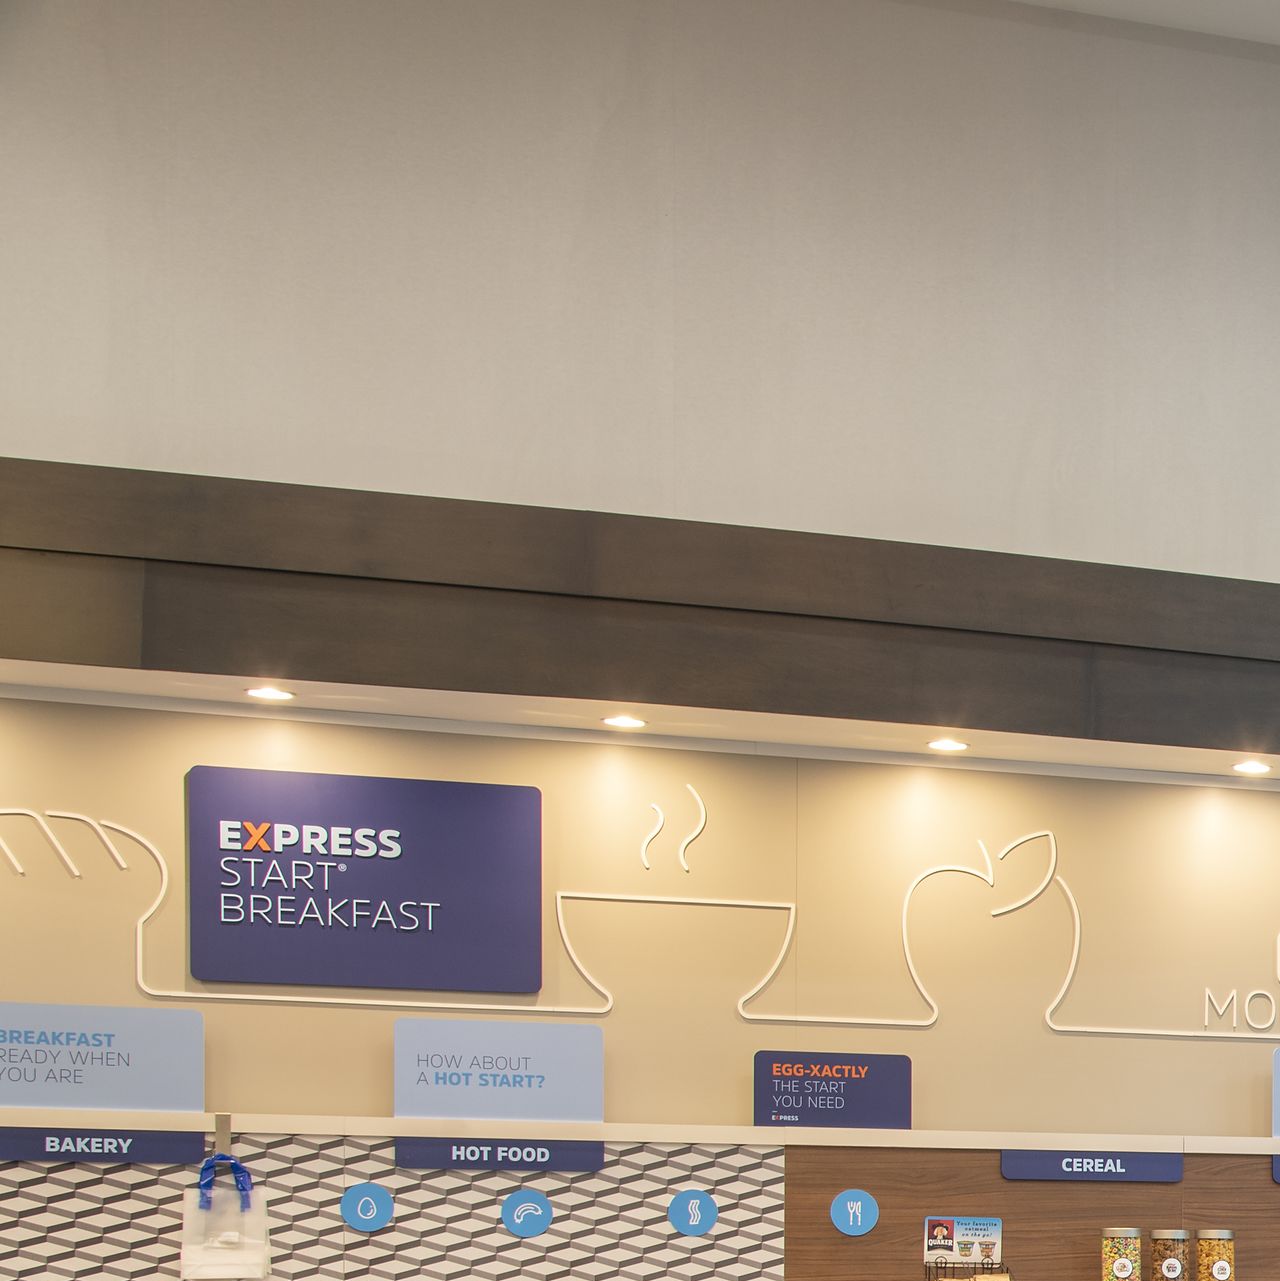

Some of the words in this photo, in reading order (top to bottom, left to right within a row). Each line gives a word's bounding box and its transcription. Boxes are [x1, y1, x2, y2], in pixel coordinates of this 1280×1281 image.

[219, 820, 402, 859] EXPRESS
[220, 893, 441, 931] BREAKFAST
[69, 1050, 130, 1067] WHEN
[417, 1053, 463, 1069] HOW
[469, 1055, 532, 1071] ABOUT
[44, 1068, 84, 1084] ARE
[772, 1063, 868, 1078] EGG-XACTLY
[416, 1071, 429, 1085] A
[434, 1071, 472, 1086] HOT
[478, 1073, 545, 1088] START?
[773, 1079, 799, 1092] THE
[804, 1080, 846, 1094] START
[773, 1095, 802, 1108] YOU
[808, 1096, 845, 1110] NEED
[45, 1136, 133, 1154] BAKERY
[451, 1145, 492, 1161] HOT
[497, 1147, 550, 1162] FOOD
[1061, 1158, 1126, 1173] CEREAL
